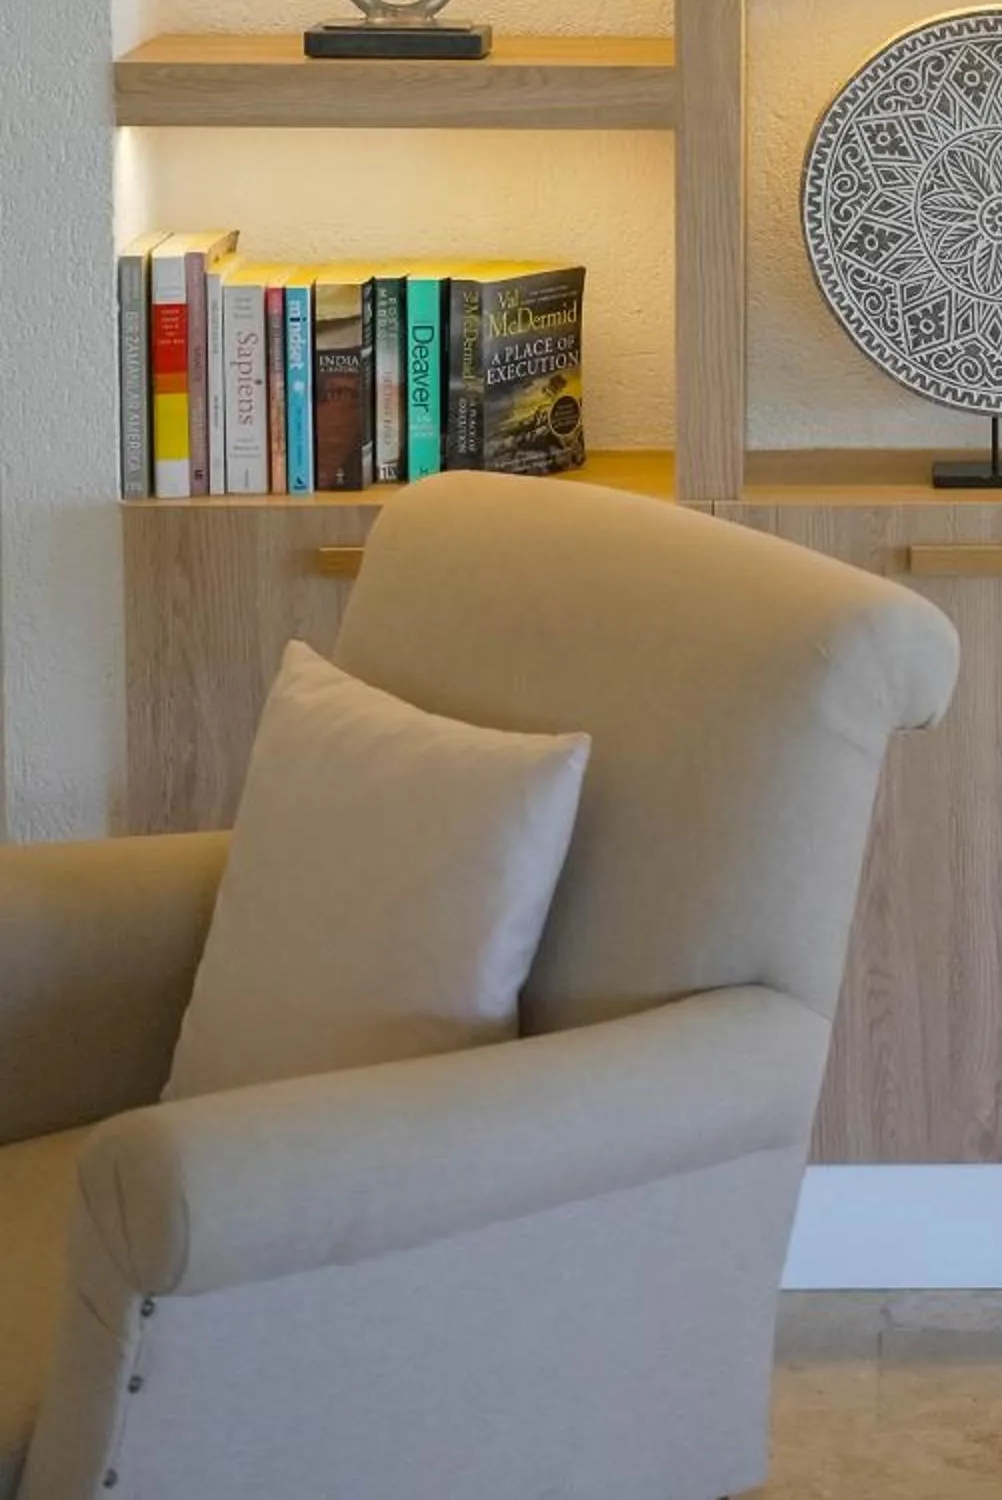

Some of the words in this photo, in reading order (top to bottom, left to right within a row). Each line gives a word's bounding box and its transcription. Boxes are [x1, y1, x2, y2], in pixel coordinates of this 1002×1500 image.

[490, 299, 578, 339] McDermid
[498, 289, 521, 311] Val
[289, 301, 307, 370] mindset
[319, 355, 359, 366] INDIA
[462, 304, 479, 380] McDermid
[491, 351, 501, 367] A
[504, 337, 554, 364] PLACE
[557, 334, 576, 353] OF
[125, 336, 142, 409] ZAMANLAR
[229, 330, 263, 426] Sapiens
[411, 324, 436, 413] Deaver
[487, 350, 580, 388] EXECUTION
[458, 397, 469, 454] EXECUTION
